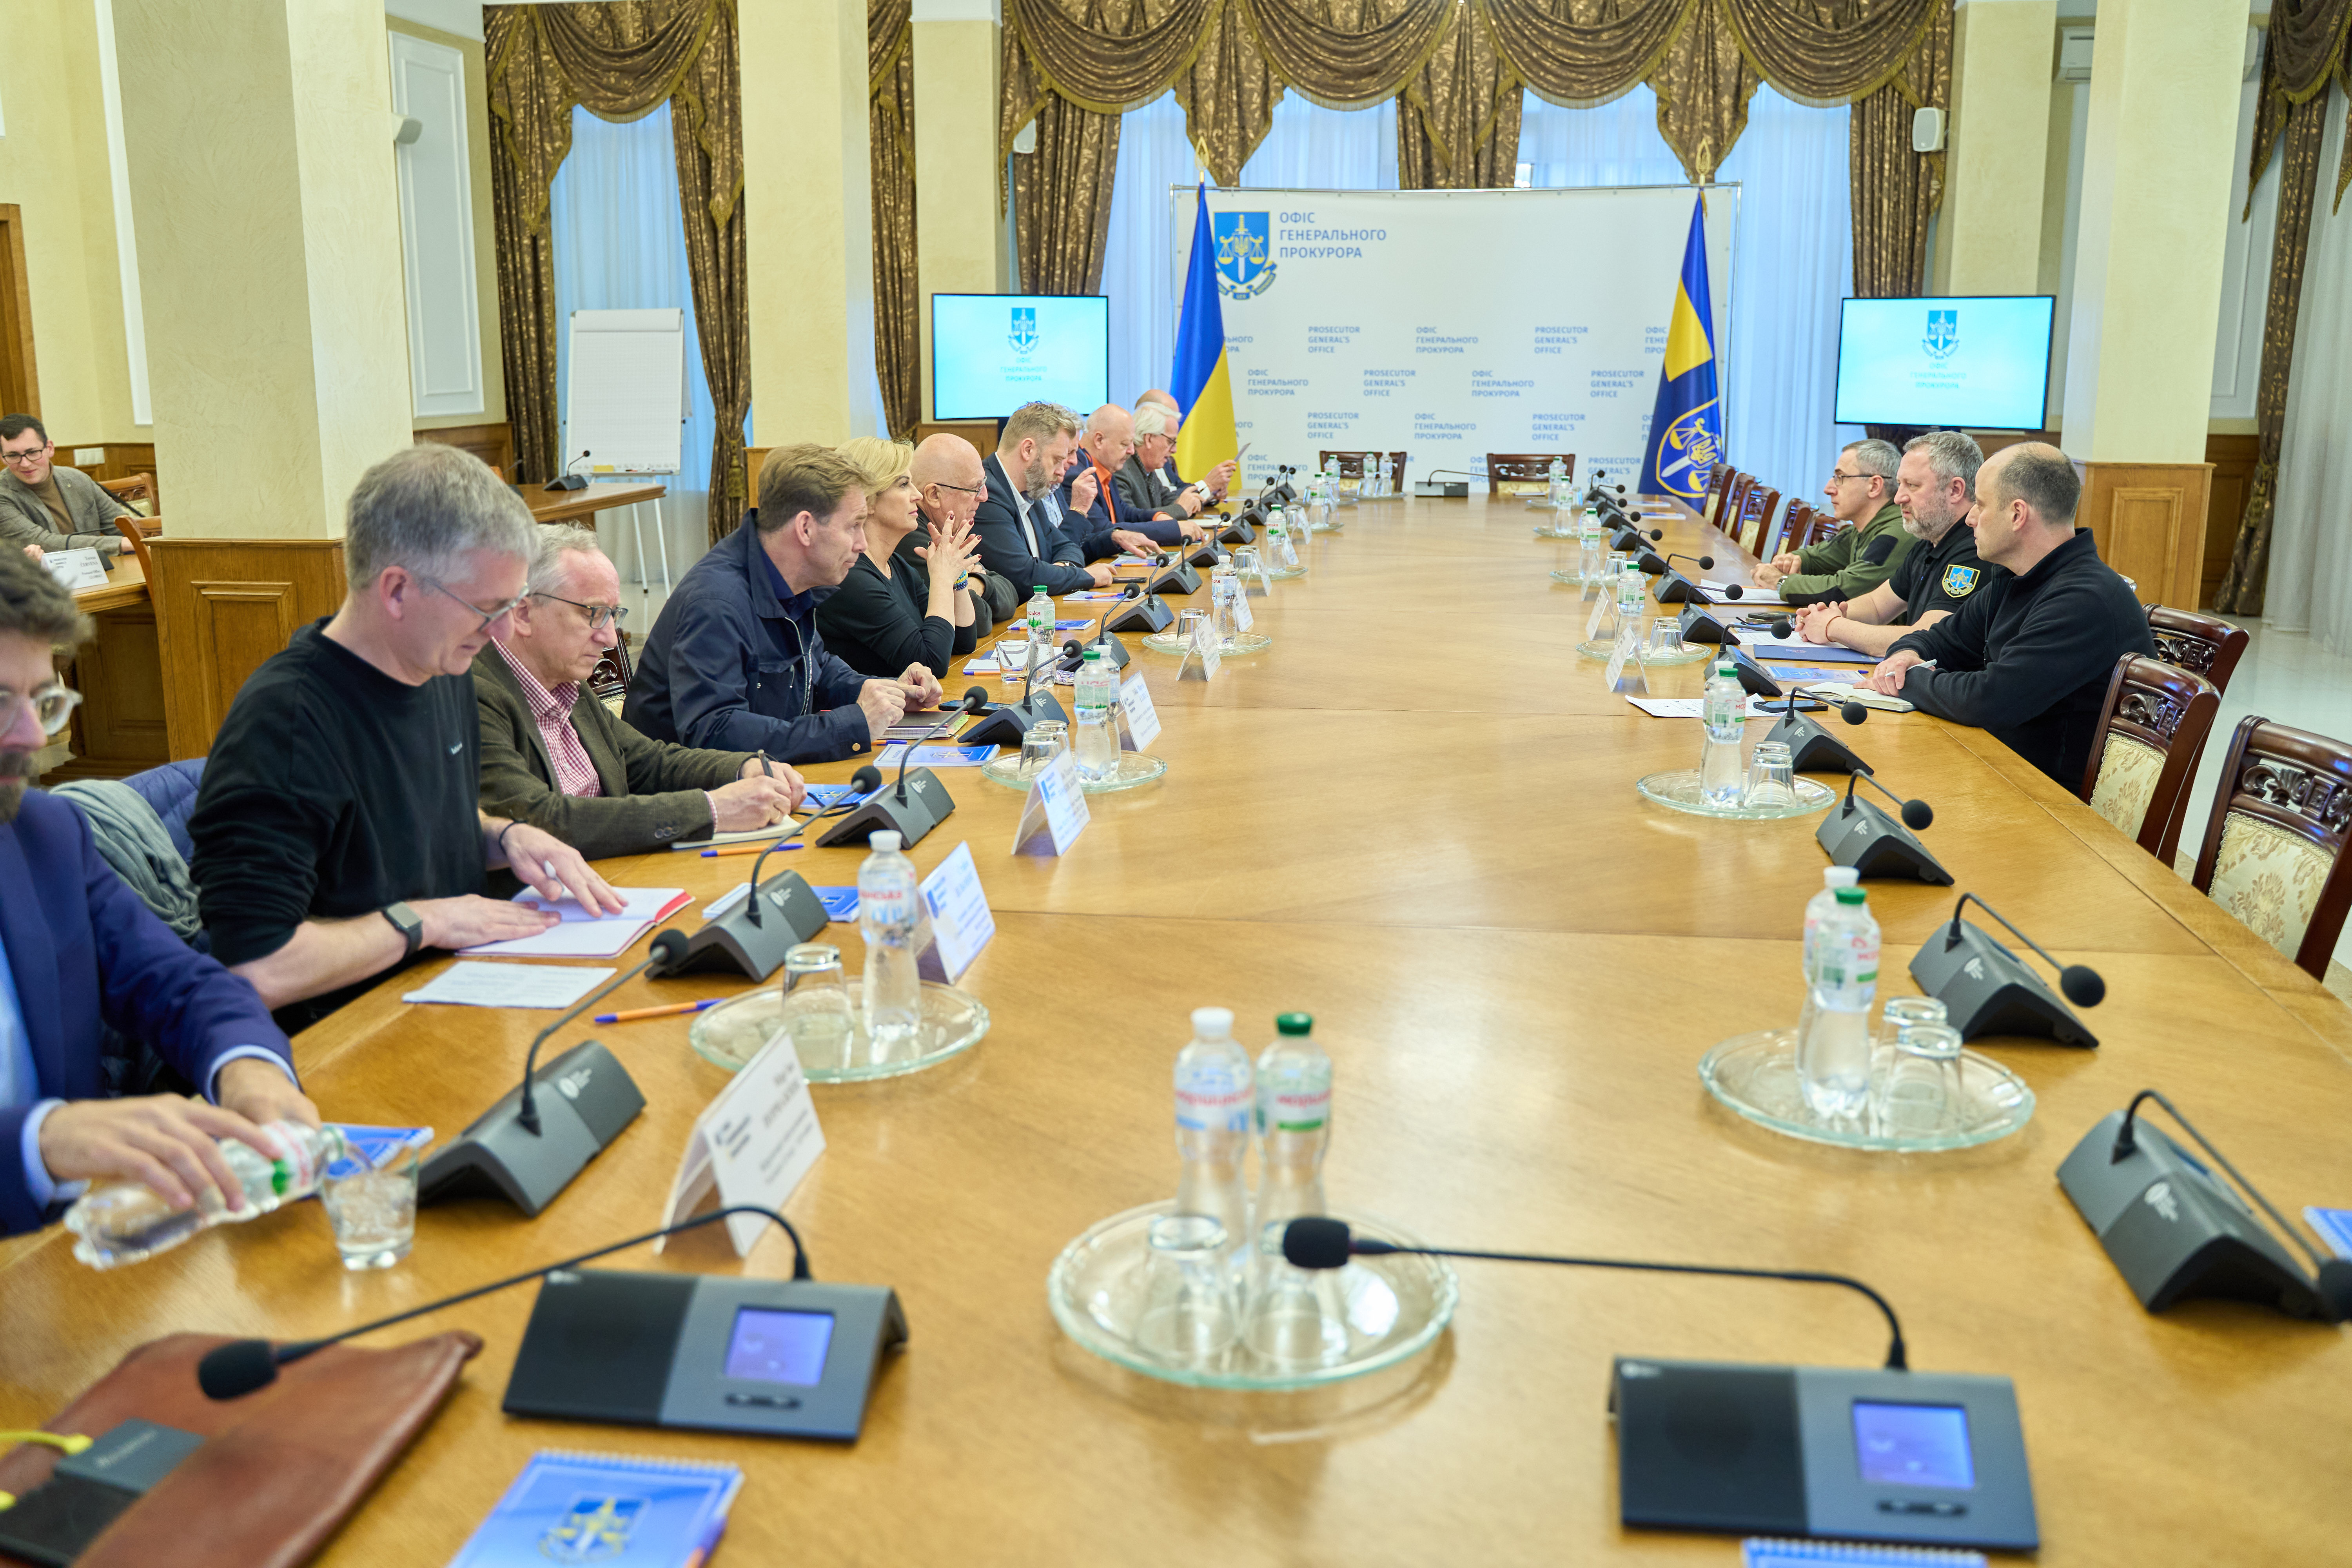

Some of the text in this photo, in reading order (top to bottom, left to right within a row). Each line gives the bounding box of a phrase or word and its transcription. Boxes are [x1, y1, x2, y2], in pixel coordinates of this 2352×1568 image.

[1279, 212, 1315, 224] ОФІС
[1280, 229, 1387, 241] ГЕНЕРАЛЬНОГО
[1280, 247, 1362, 258] ПРОКУРОРА
